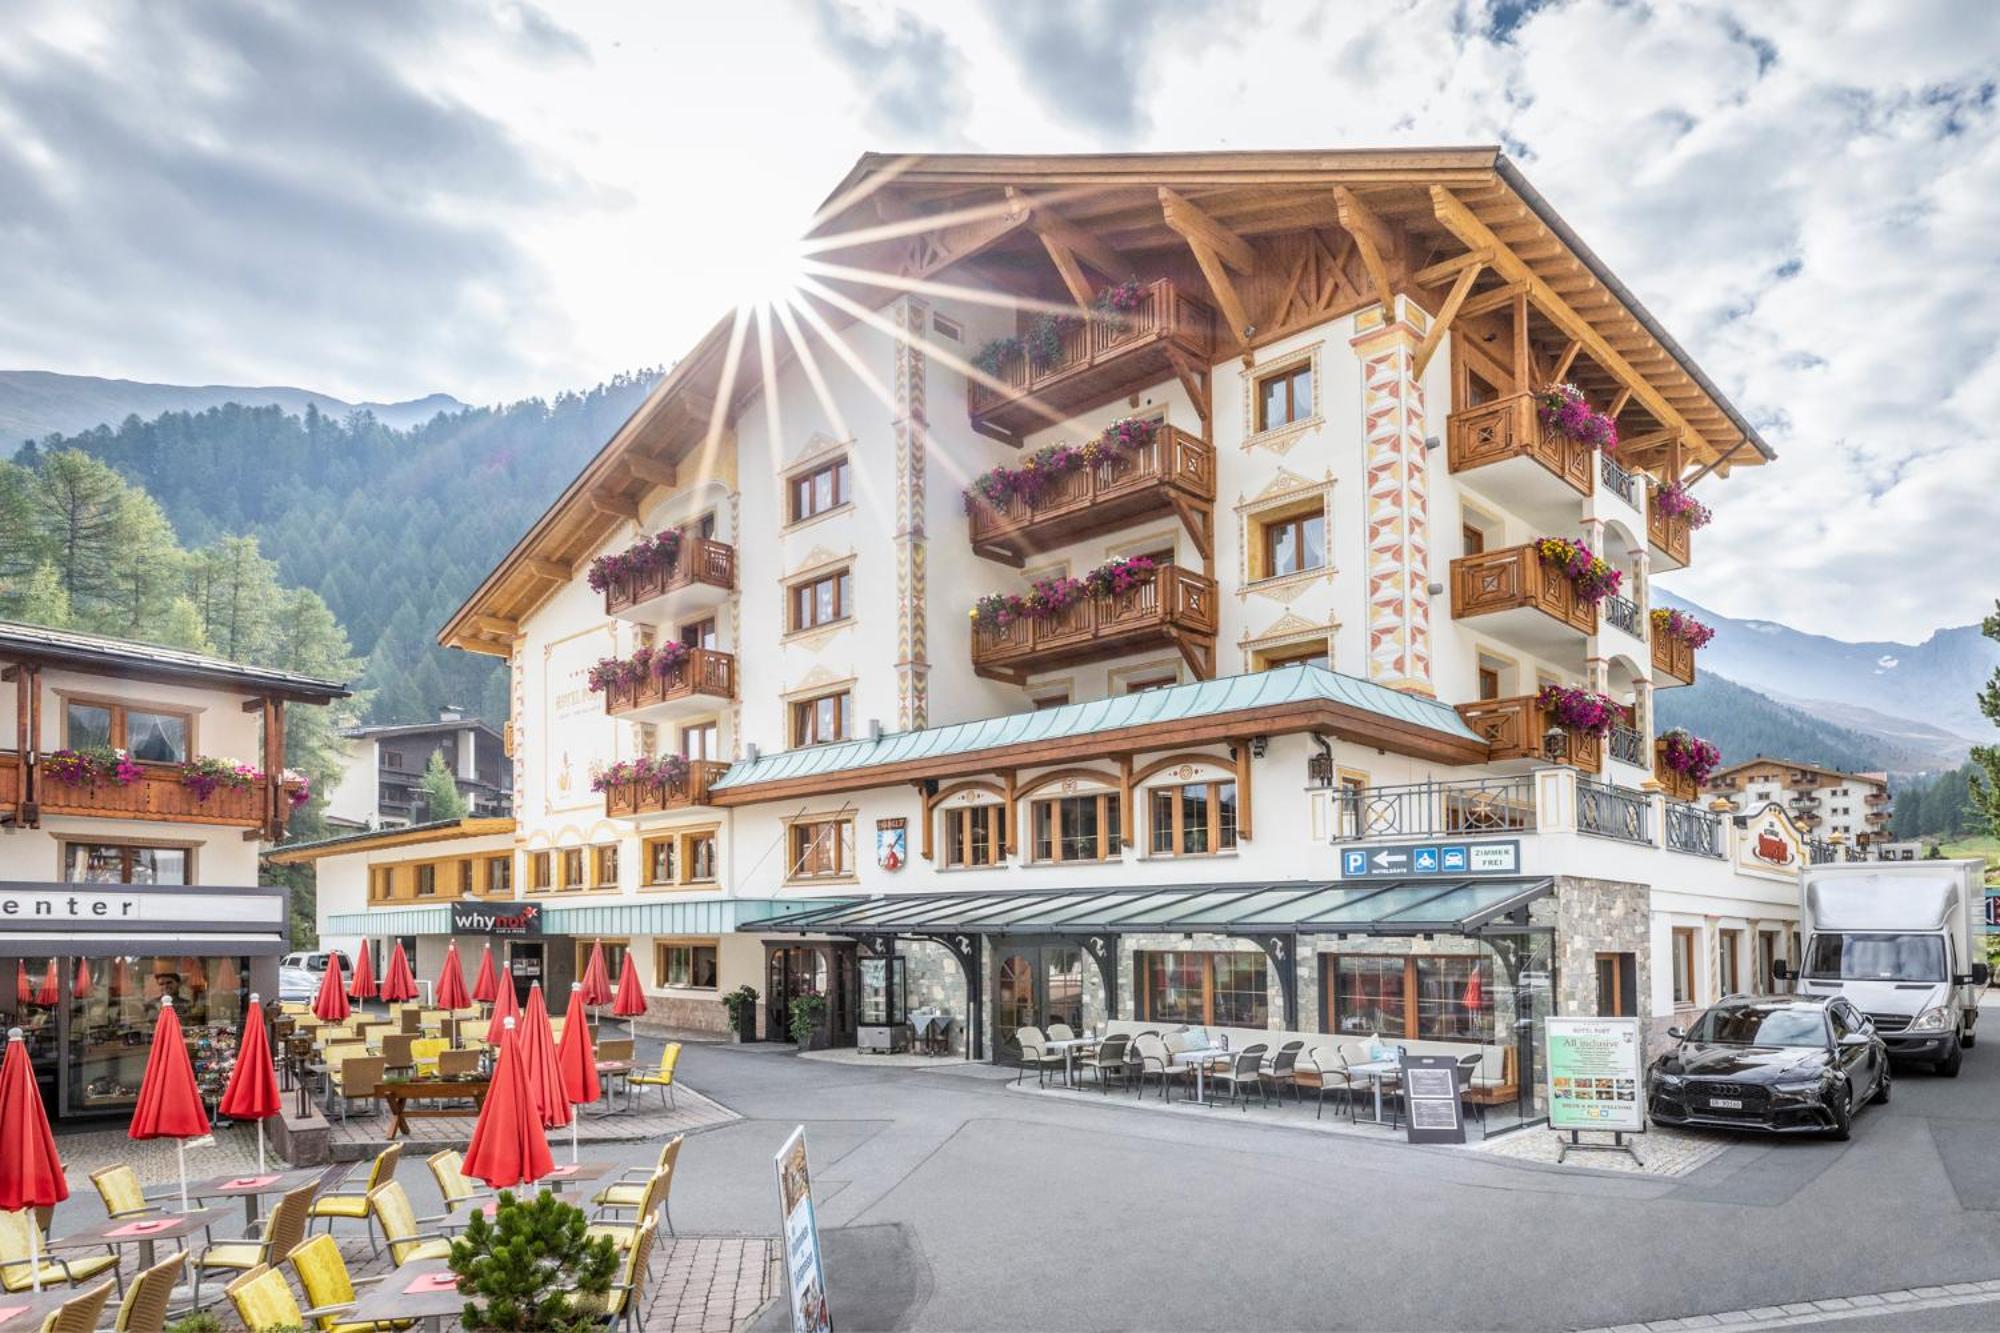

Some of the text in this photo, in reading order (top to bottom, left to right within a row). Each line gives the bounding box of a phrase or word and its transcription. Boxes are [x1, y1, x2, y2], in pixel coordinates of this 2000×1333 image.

[1475, 849, 1510, 857] ZIMMER
[1349, 855, 1361, 872] P
[1563, 1039, 1619, 1047] All inclusive
